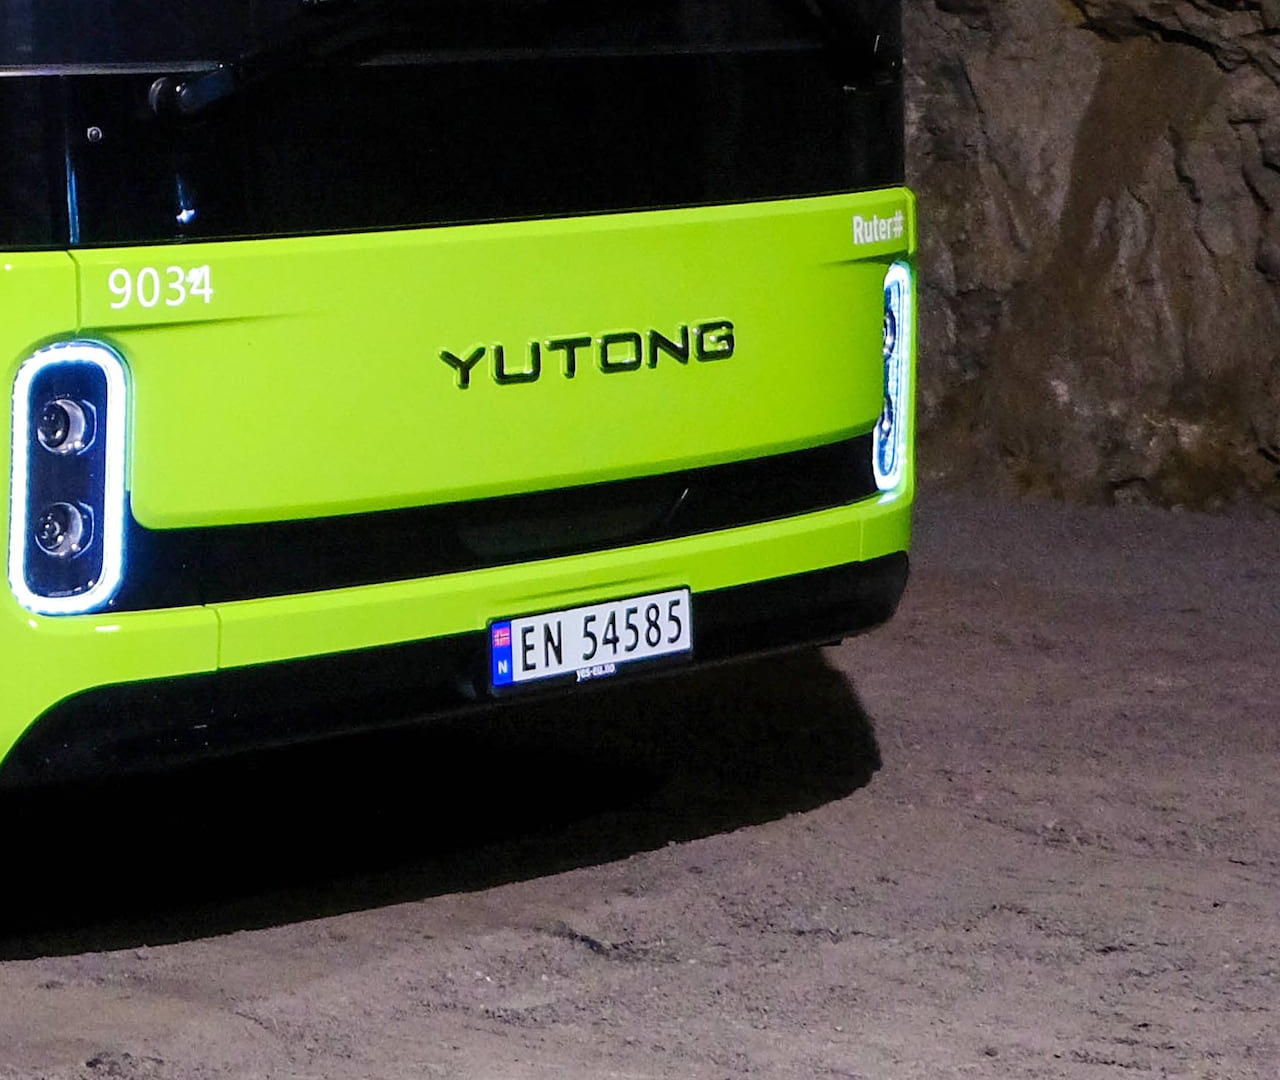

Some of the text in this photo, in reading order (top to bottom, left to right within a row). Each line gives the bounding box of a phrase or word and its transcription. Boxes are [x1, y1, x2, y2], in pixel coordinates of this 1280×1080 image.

[108, 264, 214, 310] 9034
[439, 319, 734, 390] YUTONG
[521, 599, 682, 672] EN 54585
[497, 659, 508, 674] N
